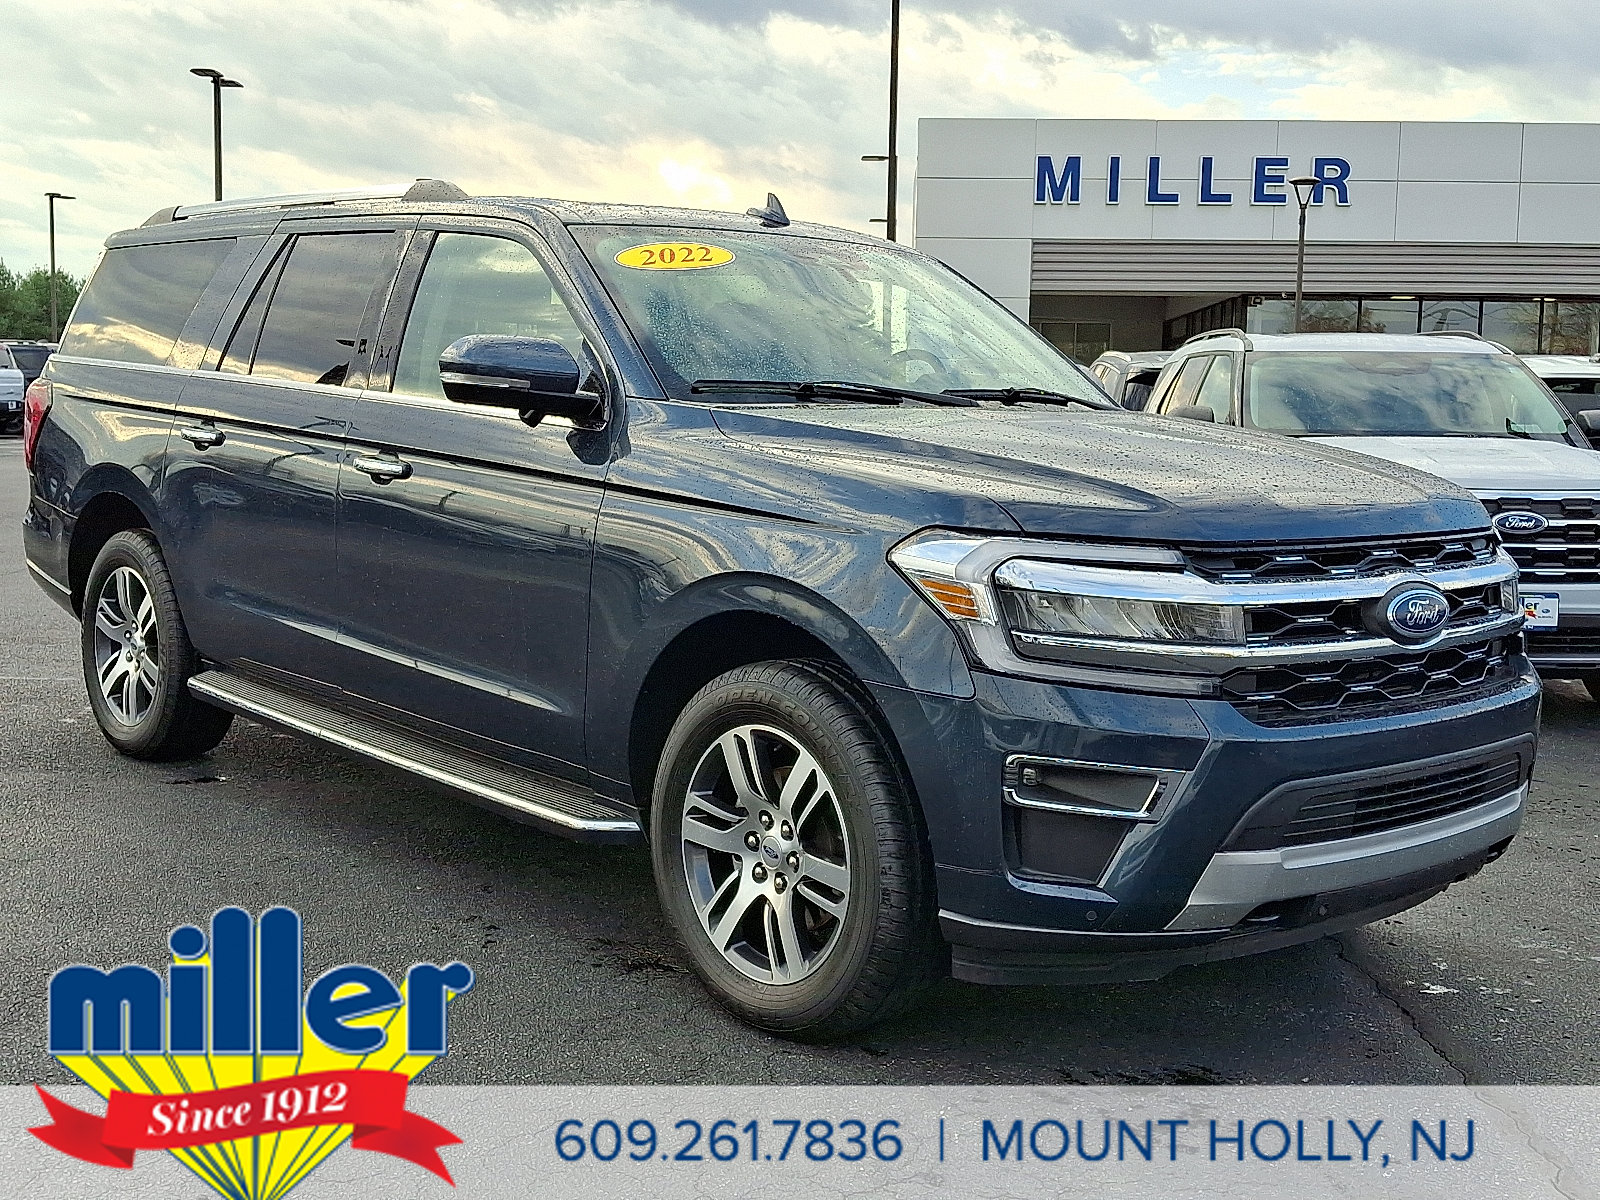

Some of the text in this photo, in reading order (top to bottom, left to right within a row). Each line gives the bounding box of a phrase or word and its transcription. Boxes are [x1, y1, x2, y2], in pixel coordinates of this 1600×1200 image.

[1034, 155, 1351, 207] MILLER
[640, 246, 713, 266] 2022
[1506, 516, 1535, 528] Ford
[1407, 600, 1439, 626] Ford
